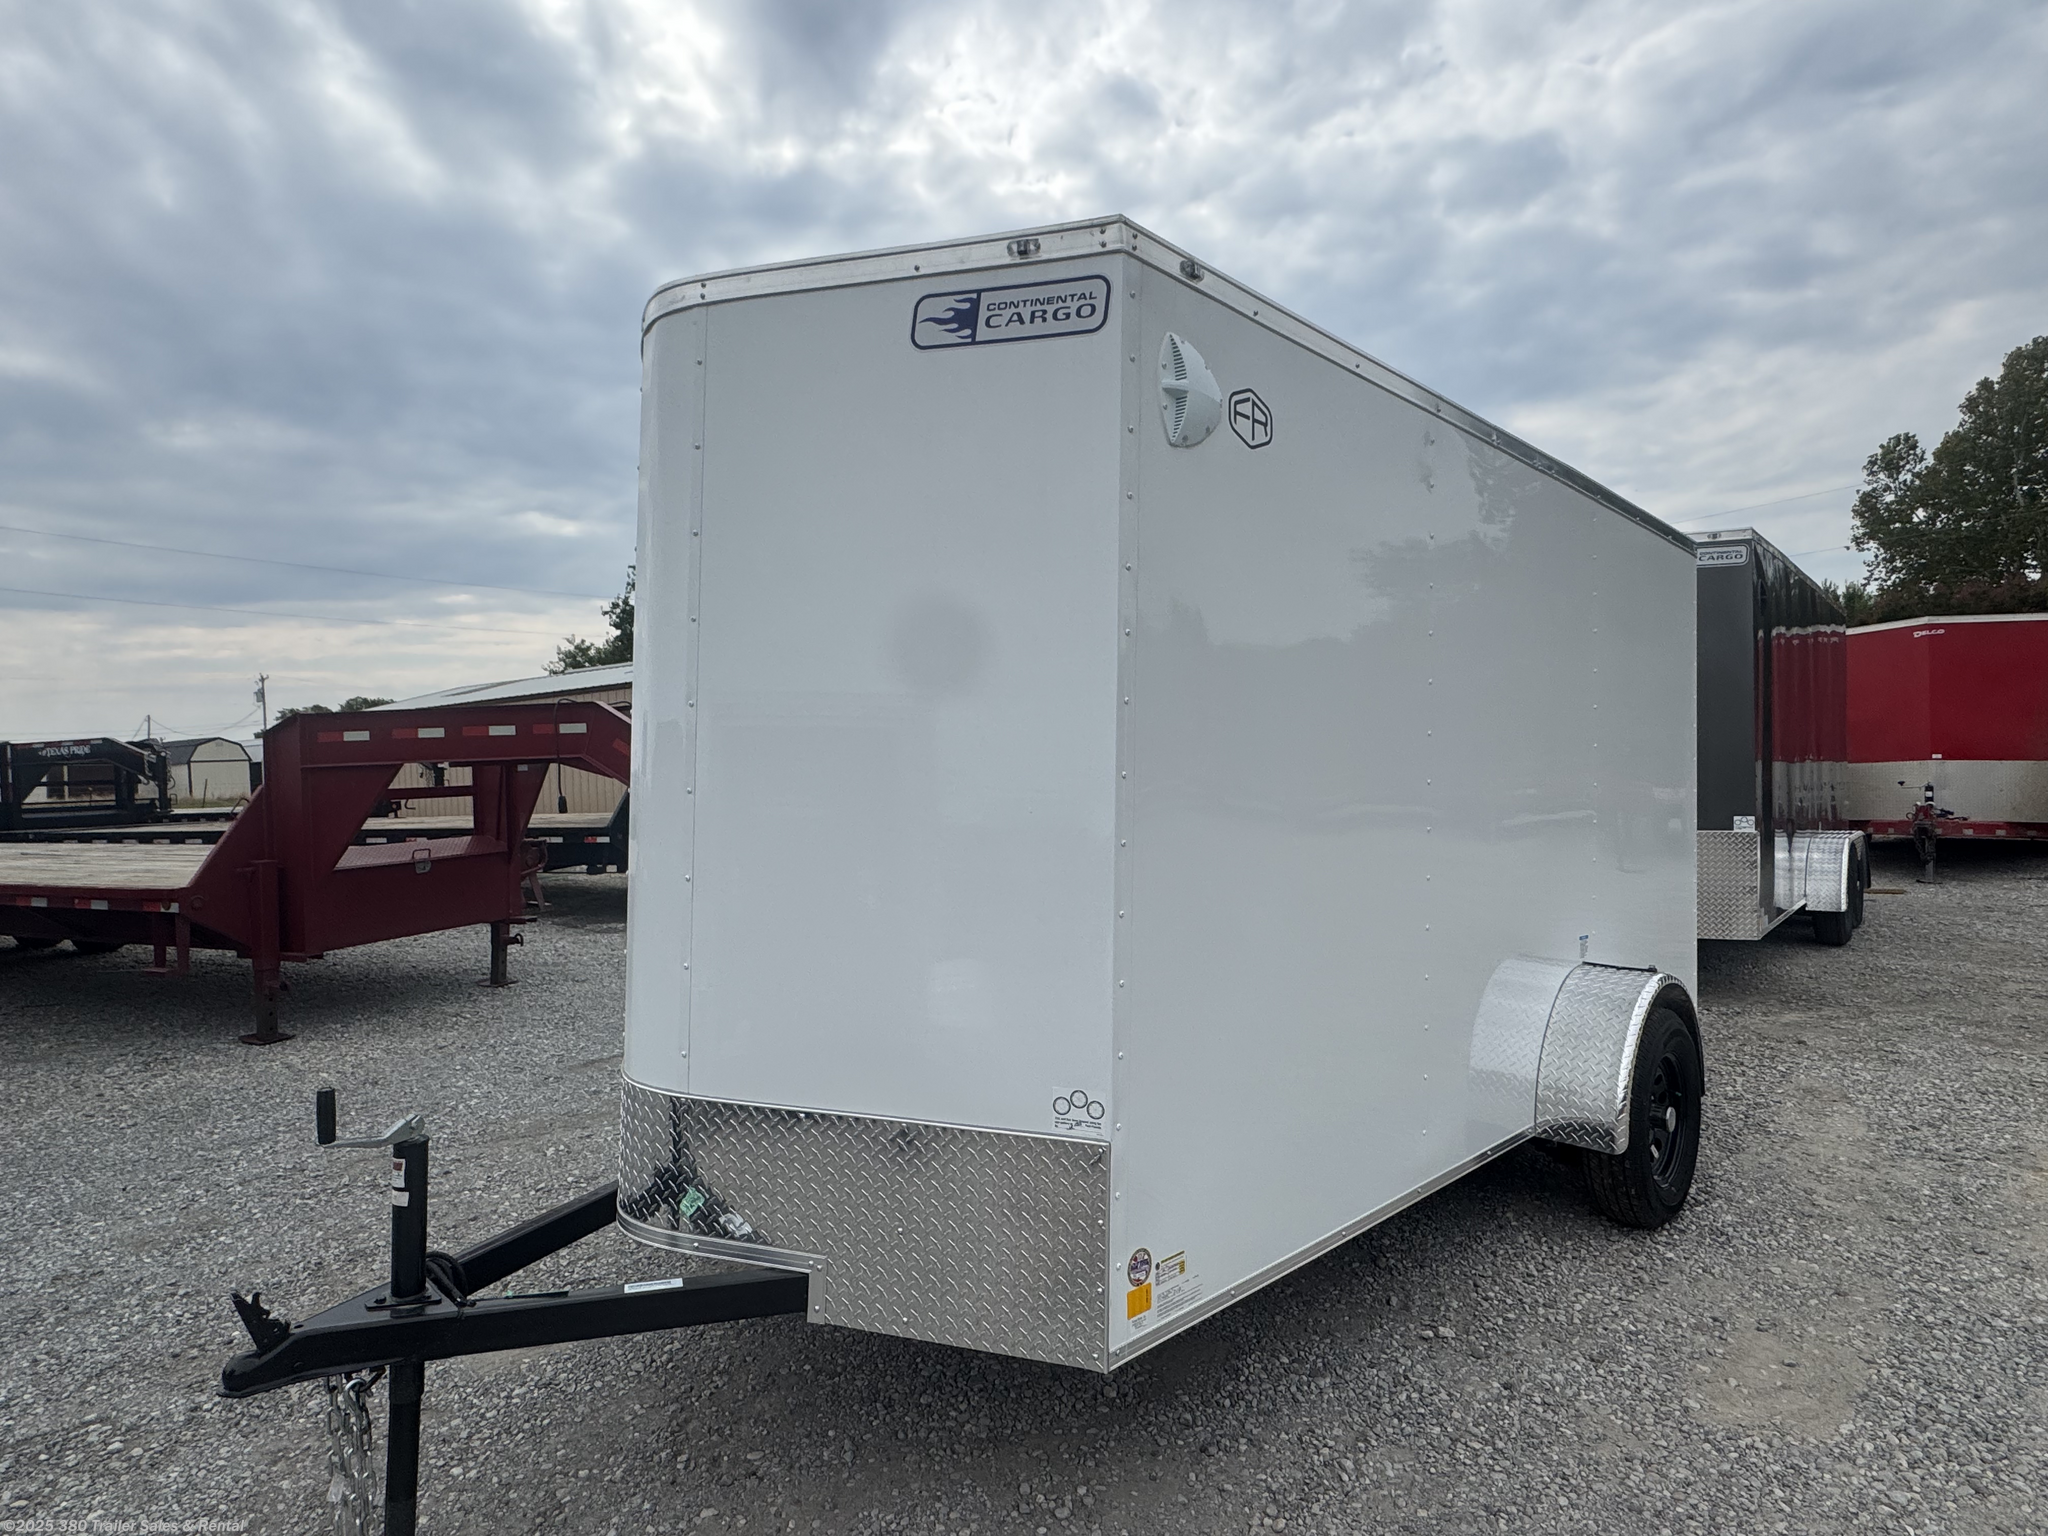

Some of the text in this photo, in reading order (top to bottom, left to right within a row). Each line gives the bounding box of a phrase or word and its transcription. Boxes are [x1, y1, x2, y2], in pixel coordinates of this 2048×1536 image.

[986, 290, 1097, 312] CONTINENTAL
[984, 303, 1097, 329] CARGO
[1698, 553, 1743, 561] CARGO
